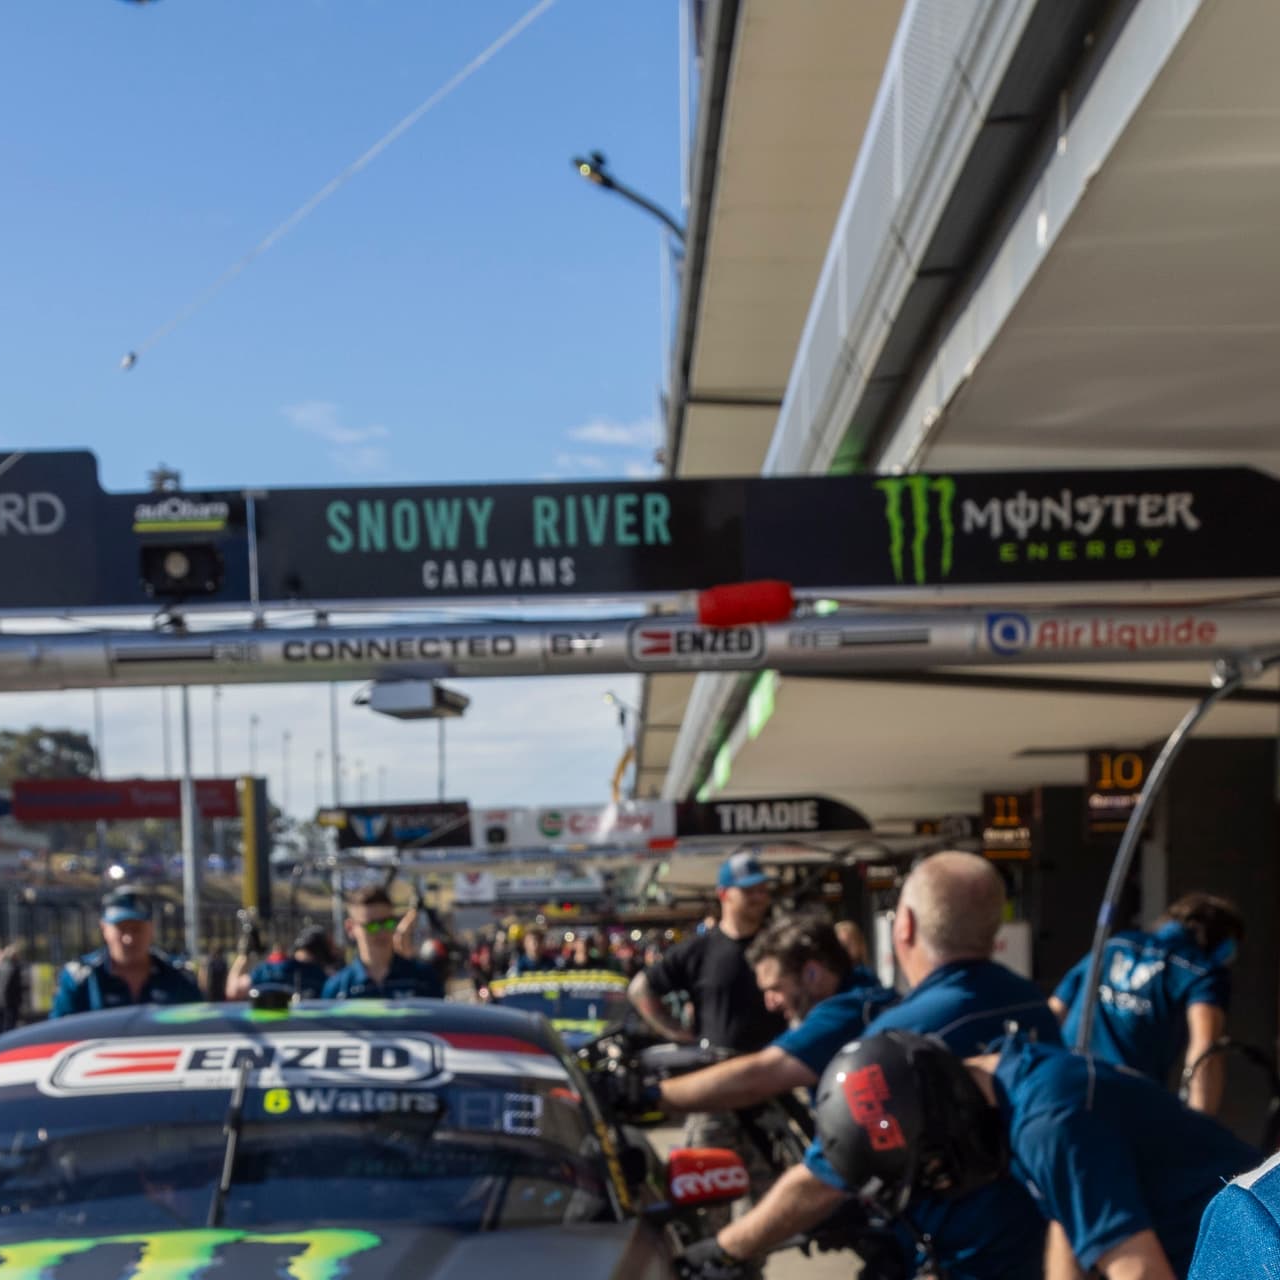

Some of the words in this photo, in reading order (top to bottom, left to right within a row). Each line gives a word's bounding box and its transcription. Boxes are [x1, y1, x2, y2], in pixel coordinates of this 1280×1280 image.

[326, 498, 494, 553] SNOWY
[533, 493, 671, 547] RIVER
[962, 489, 1201, 539] MONSTER
[999, 539, 1163, 562] ENERGY
[422, 556, 576, 589] CARAVANS
[282, 634, 516, 662] CONNECTED
[551, 632, 601, 658] BY
[673, 626, 754, 657] ENZED
[1037, 619, 1086, 649] Air
[1092, 618, 1218, 652] Liquide
[1097, 752, 1144, 789] 10
[716, 799, 820, 832] TRADIE
[993, 795, 1020, 826] 11
[186, 1046, 412, 1071] ENZED
[263, 1088, 291, 1114] 6
[294, 1089, 439, 1114] Waters
